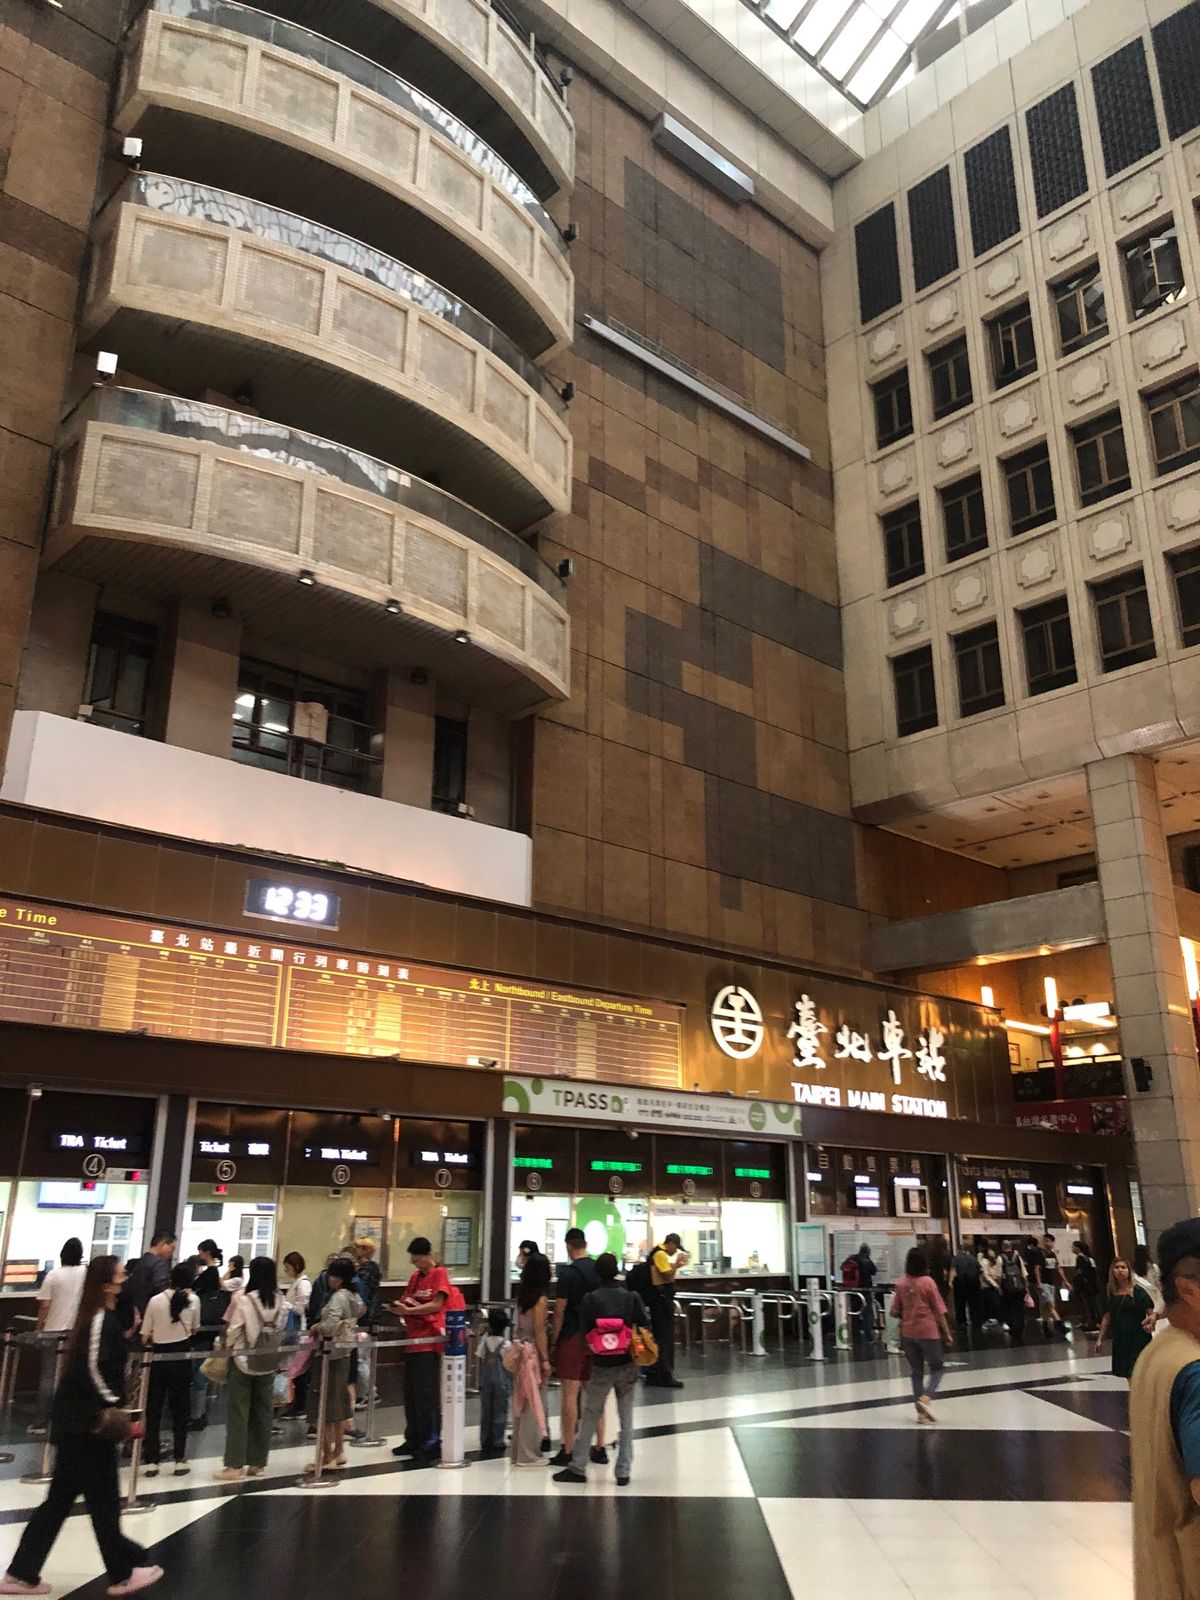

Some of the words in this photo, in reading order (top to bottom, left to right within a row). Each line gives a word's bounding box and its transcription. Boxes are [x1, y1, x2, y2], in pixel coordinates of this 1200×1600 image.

[16, 908, 57, 926] Time
[468, 978, 490, 992] 北上
[494, 983, 546, 999] Northbound
[551, 991, 594, 1007] Eastbound
[634, 1004, 653, 1015] Time
[787, 993, 947, 1085] 臺北車站
[552, 1089, 608, 1111] TPASS
[791, 1082, 840, 1107] TAIPEI
[848, 1089, 885, 1111] MAIN
[892, 1094, 947, 1118] STATION
[60, 1133, 84, 1148] TRA
[94, 1136, 127, 1150] Ticket
